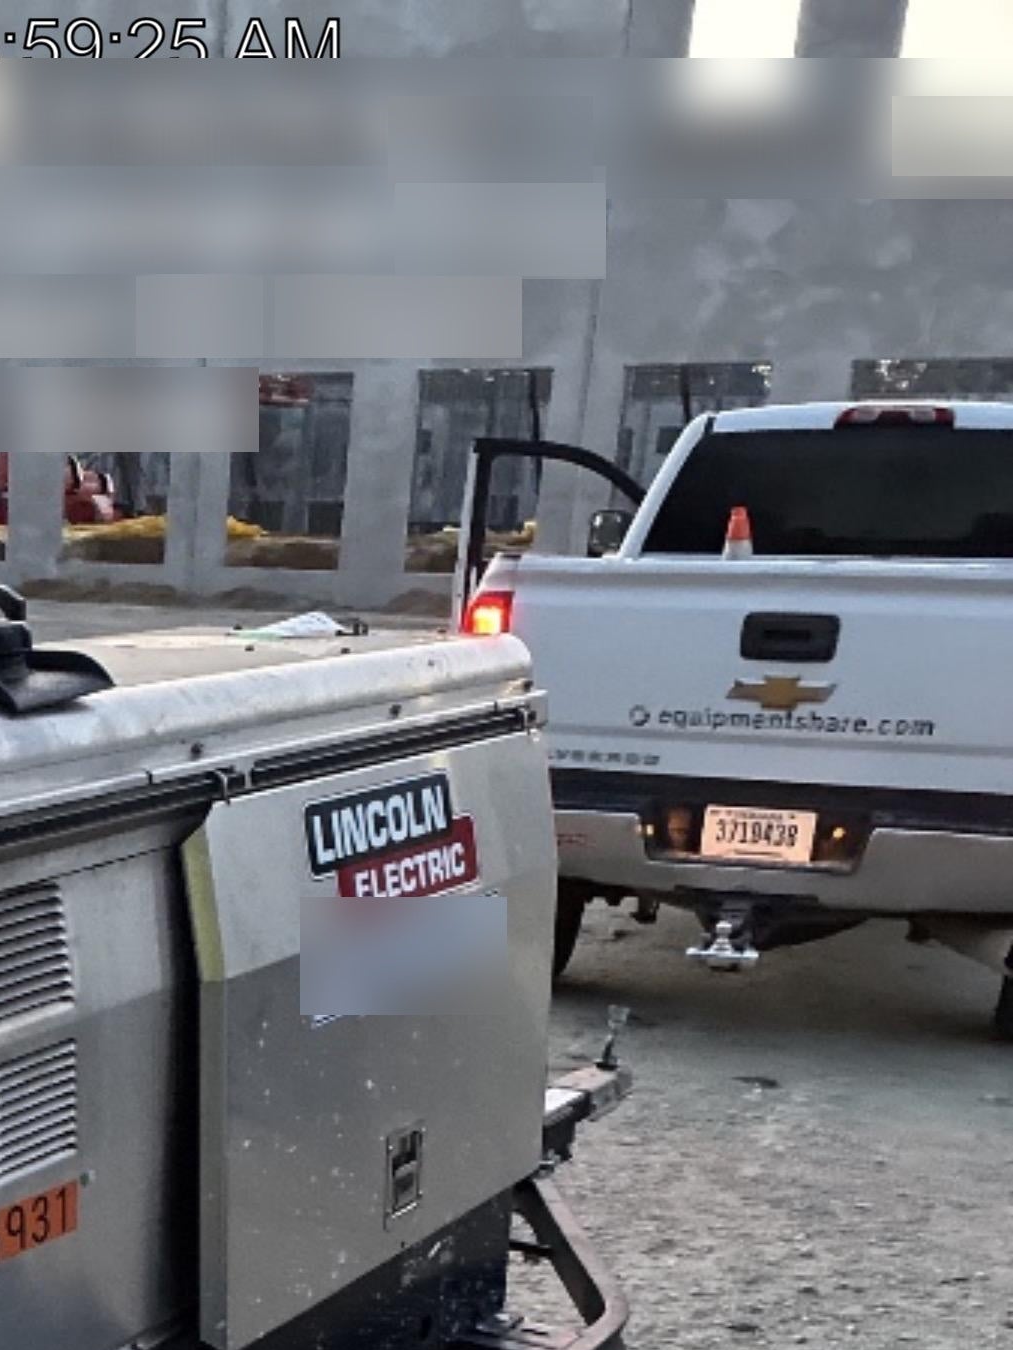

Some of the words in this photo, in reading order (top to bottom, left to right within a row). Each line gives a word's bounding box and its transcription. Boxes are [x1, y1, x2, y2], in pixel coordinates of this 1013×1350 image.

[658, 708, 936, 736] equipmentshare.com
[312, 784, 448, 865] LINCOLN
[353, 842, 466, 897] ELECTRIC
